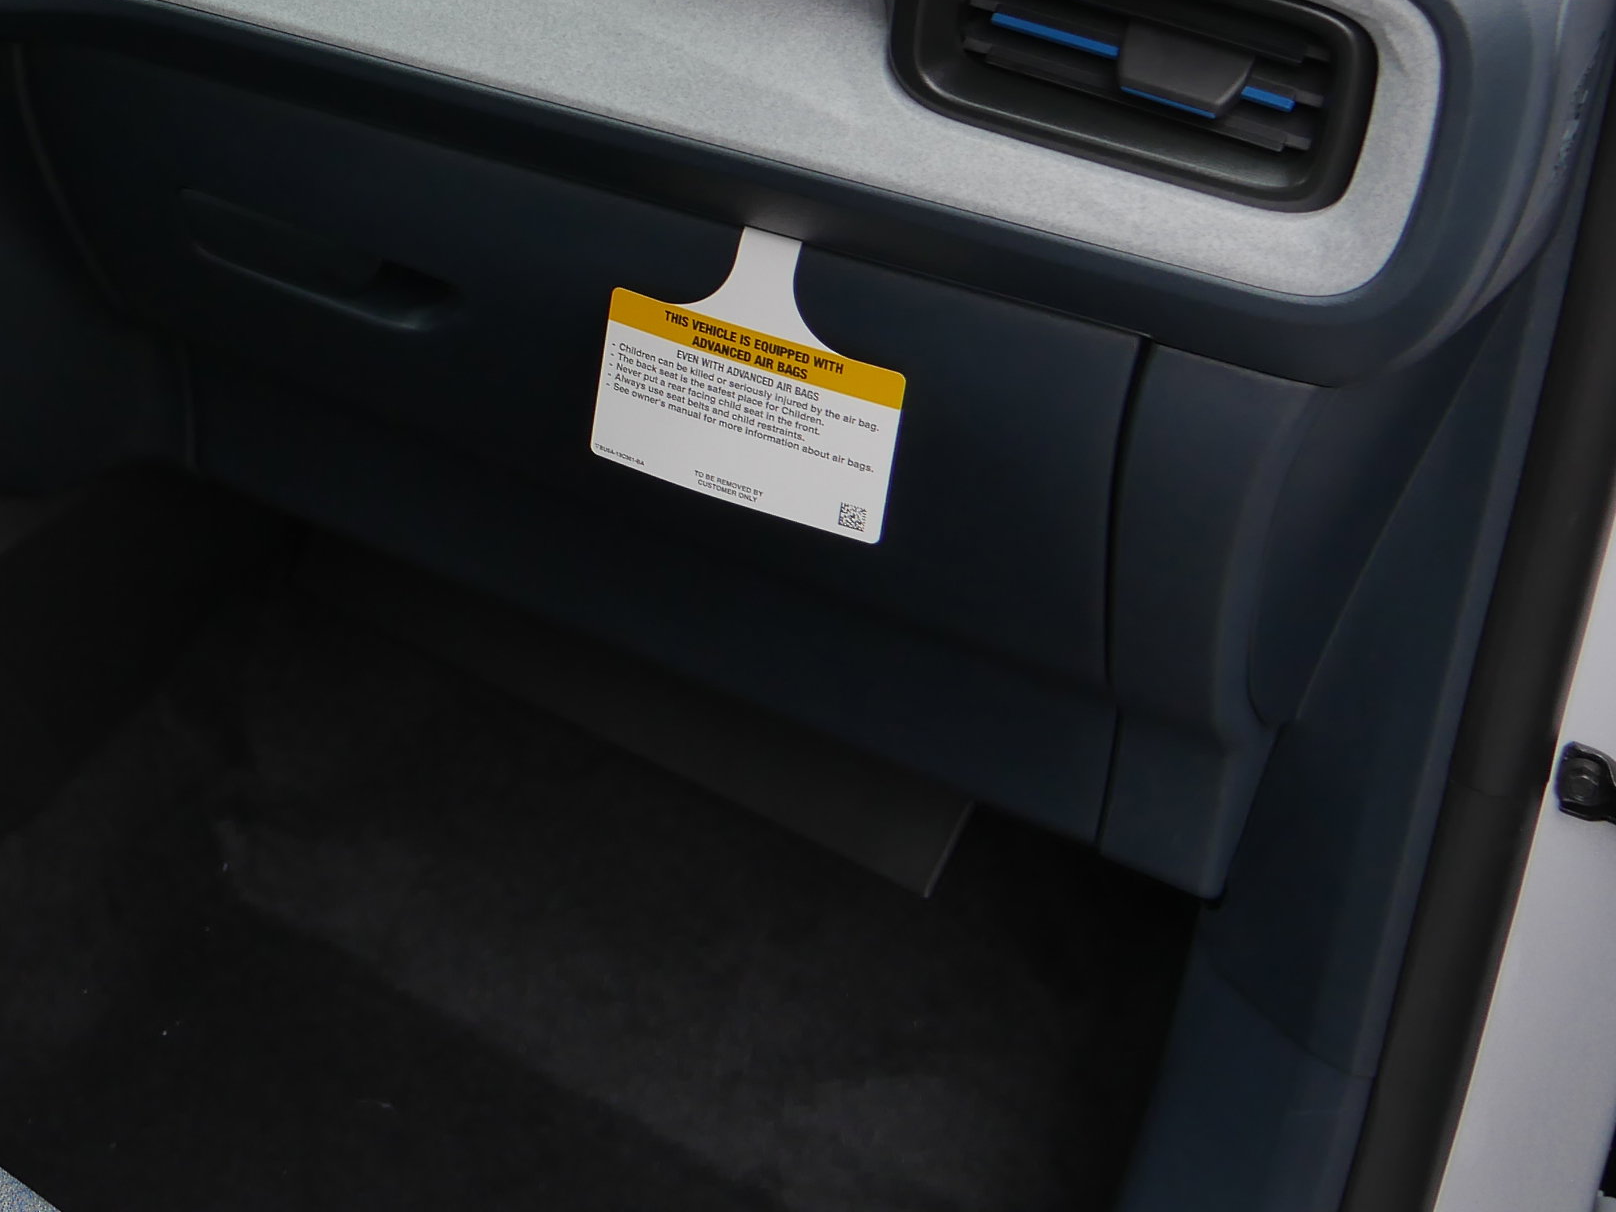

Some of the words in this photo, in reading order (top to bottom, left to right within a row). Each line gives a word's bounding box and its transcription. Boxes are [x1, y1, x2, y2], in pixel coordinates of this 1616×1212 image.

[665, 310, 689, 327] THIS
[692, 319, 737, 342] VEHICLE
[740, 334, 751, 346] IS
[754, 339, 809, 364] EQUIPPED
[814, 356, 843, 374] WITH
[677, 349, 699, 364] EVEN
[702, 358, 725, 373] WITH
[726, 366, 774, 387] ADVANCED
[776, 381, 792, 393] AIR
[795, 386, 819, 401] BAGS
[692, 336, 751, 362] ADVANCED
[754, 355, 773, 369] AIR
[777, 361, 807, 379] BAGS
[615, 373, 646, 390] Always
[648, 386, 664, 396] use
[666, 392, 685, 404] seat
[687, 398, 711, 412] belts
[712, 403, 730, 418] and
[732, 414, 755, 426] child
[757, 422, 805, 441] restraints.
[616, 363, 642, 377] Never
[643, 374, 658, 384] put
[668, 382, 686, 393] rear
[688, 387, 716, 403] facing
[718, 399, 741, 411] child
[744, 407, 763, 418] seat
[766, 412, 775, 421] in
[778, 416, 792, 427] the
[795, 421, 820, 435] front.
[618, 352, 634, 365] The
[636, 359, 657, 373] back
[659, 369, 678, 380] seat
[680, 374, 688, 383] is
[690, 378, 705, 389] the
[707, 385, 735, 399] safest
[737, 394, 763, 407] place
[766, 399, 780, 412] for
[781, 406, 824, 426] Children.
[619, 343, 656, 362] Children
[658, 358, 674, 368] can
[676, 362, 688, 373] be
[690, 367, 715, 381] killed
[716, 377, 727, 385] or
[729, 381, 772, 399] seriously
[775, 393, 808, 410] injured
[810, 404, 822, 415] by
[825, 409, 840, 420] the
[843, 416, 856, 424] air
[858, 419, 879, 432] bag.
[613, 383, 629, 394] See
[631, 391, 665, 407] owner's
[668, 403, 701, 419] manual
[704, 414, 717, 424] for
[719, 420, 743, 432] more
[745, 427, 799, 450] information
[802, 446, 830, 459] about
[832, 455, 845, 463] air
[847, 458, 873, 472] bags.
[695, 470, 704, 478] TO
[705, 473, 715, 482] BE
[716, 477, 752, 494] REMOVED
[753, 489, 763, 497] BY
[698, 479, 737, 497] CUSTOMER
[738, 492, 757, 503] ONLY
